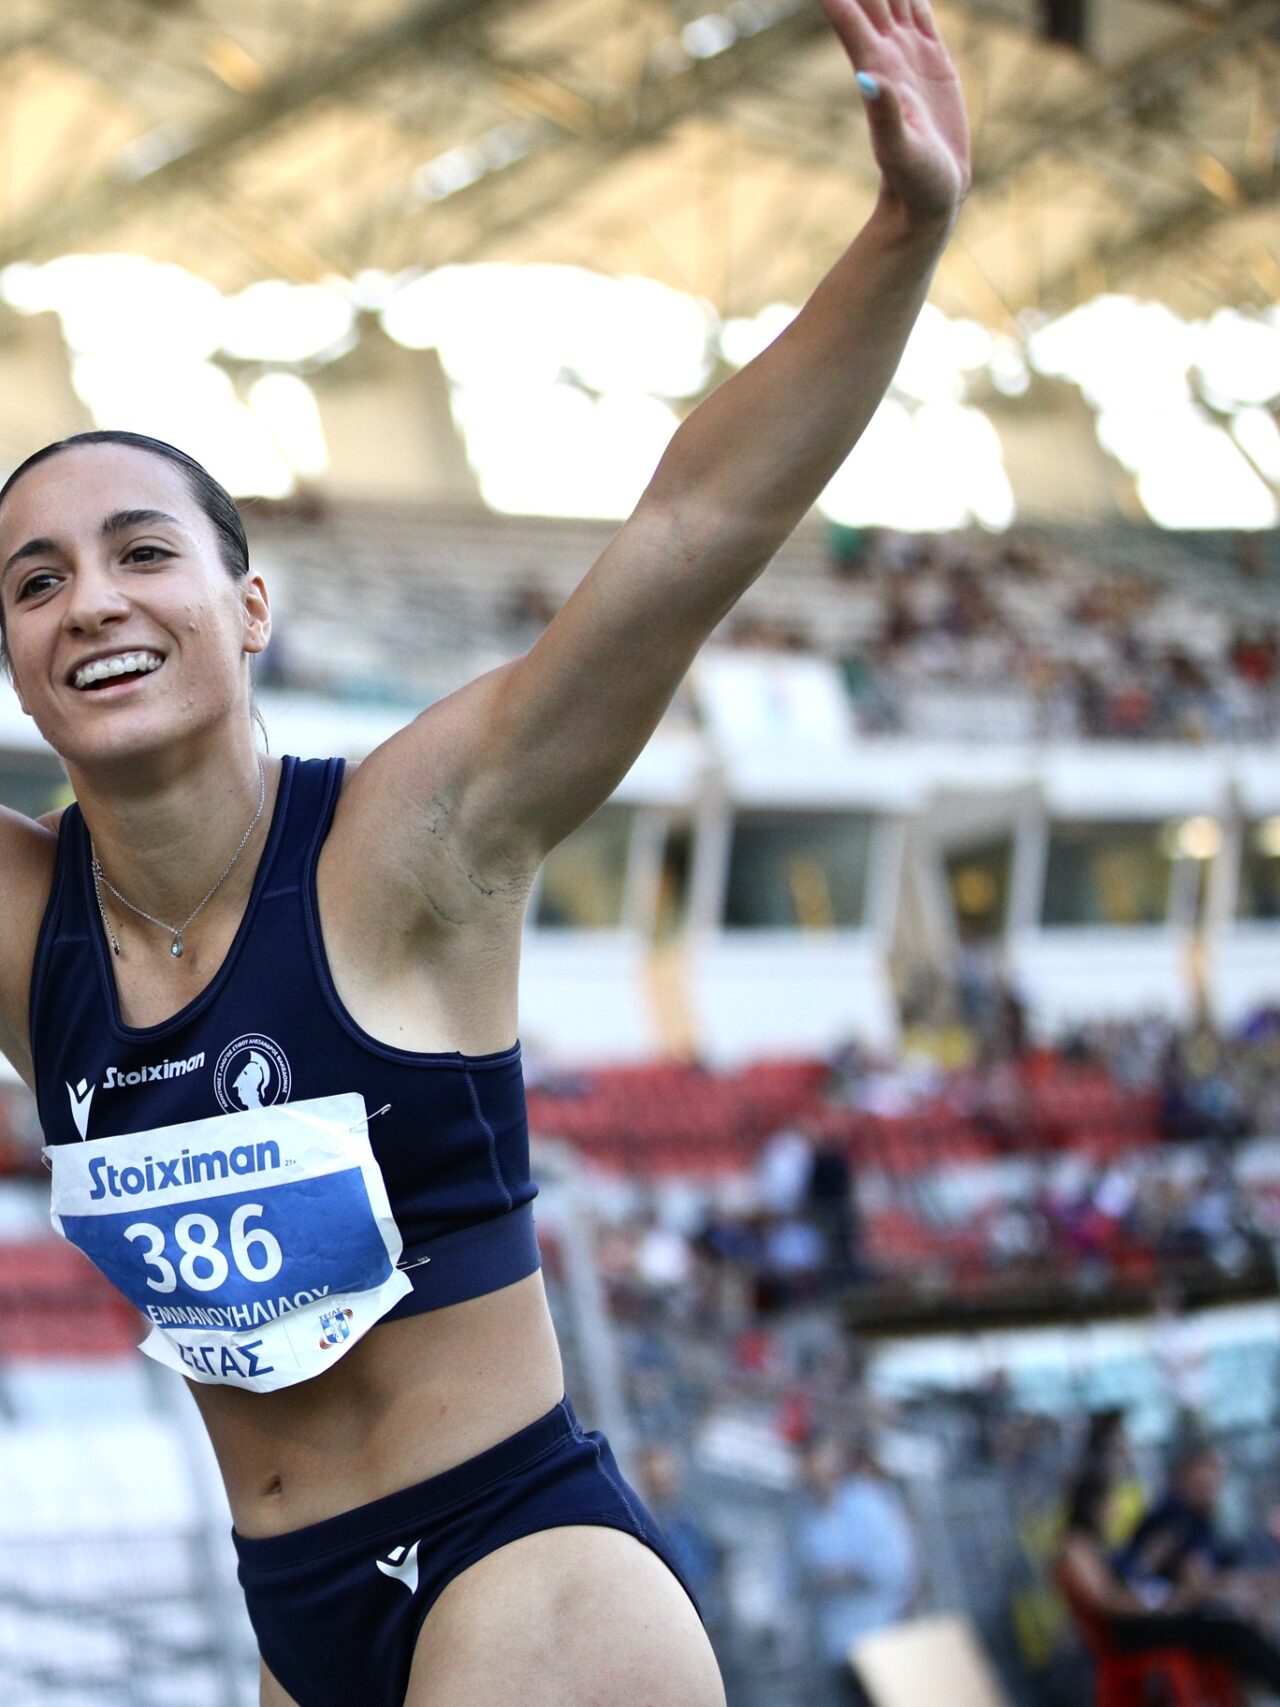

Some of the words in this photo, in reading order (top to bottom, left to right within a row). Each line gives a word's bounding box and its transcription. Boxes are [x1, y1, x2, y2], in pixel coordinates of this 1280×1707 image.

[102, 1051, 205, 1089] Stoiximan
[88, 1139, 281, 1201] Stoiximan
[284, 1158, 297, 1167] 21+
[123, 1203, 283, 1294] 386
